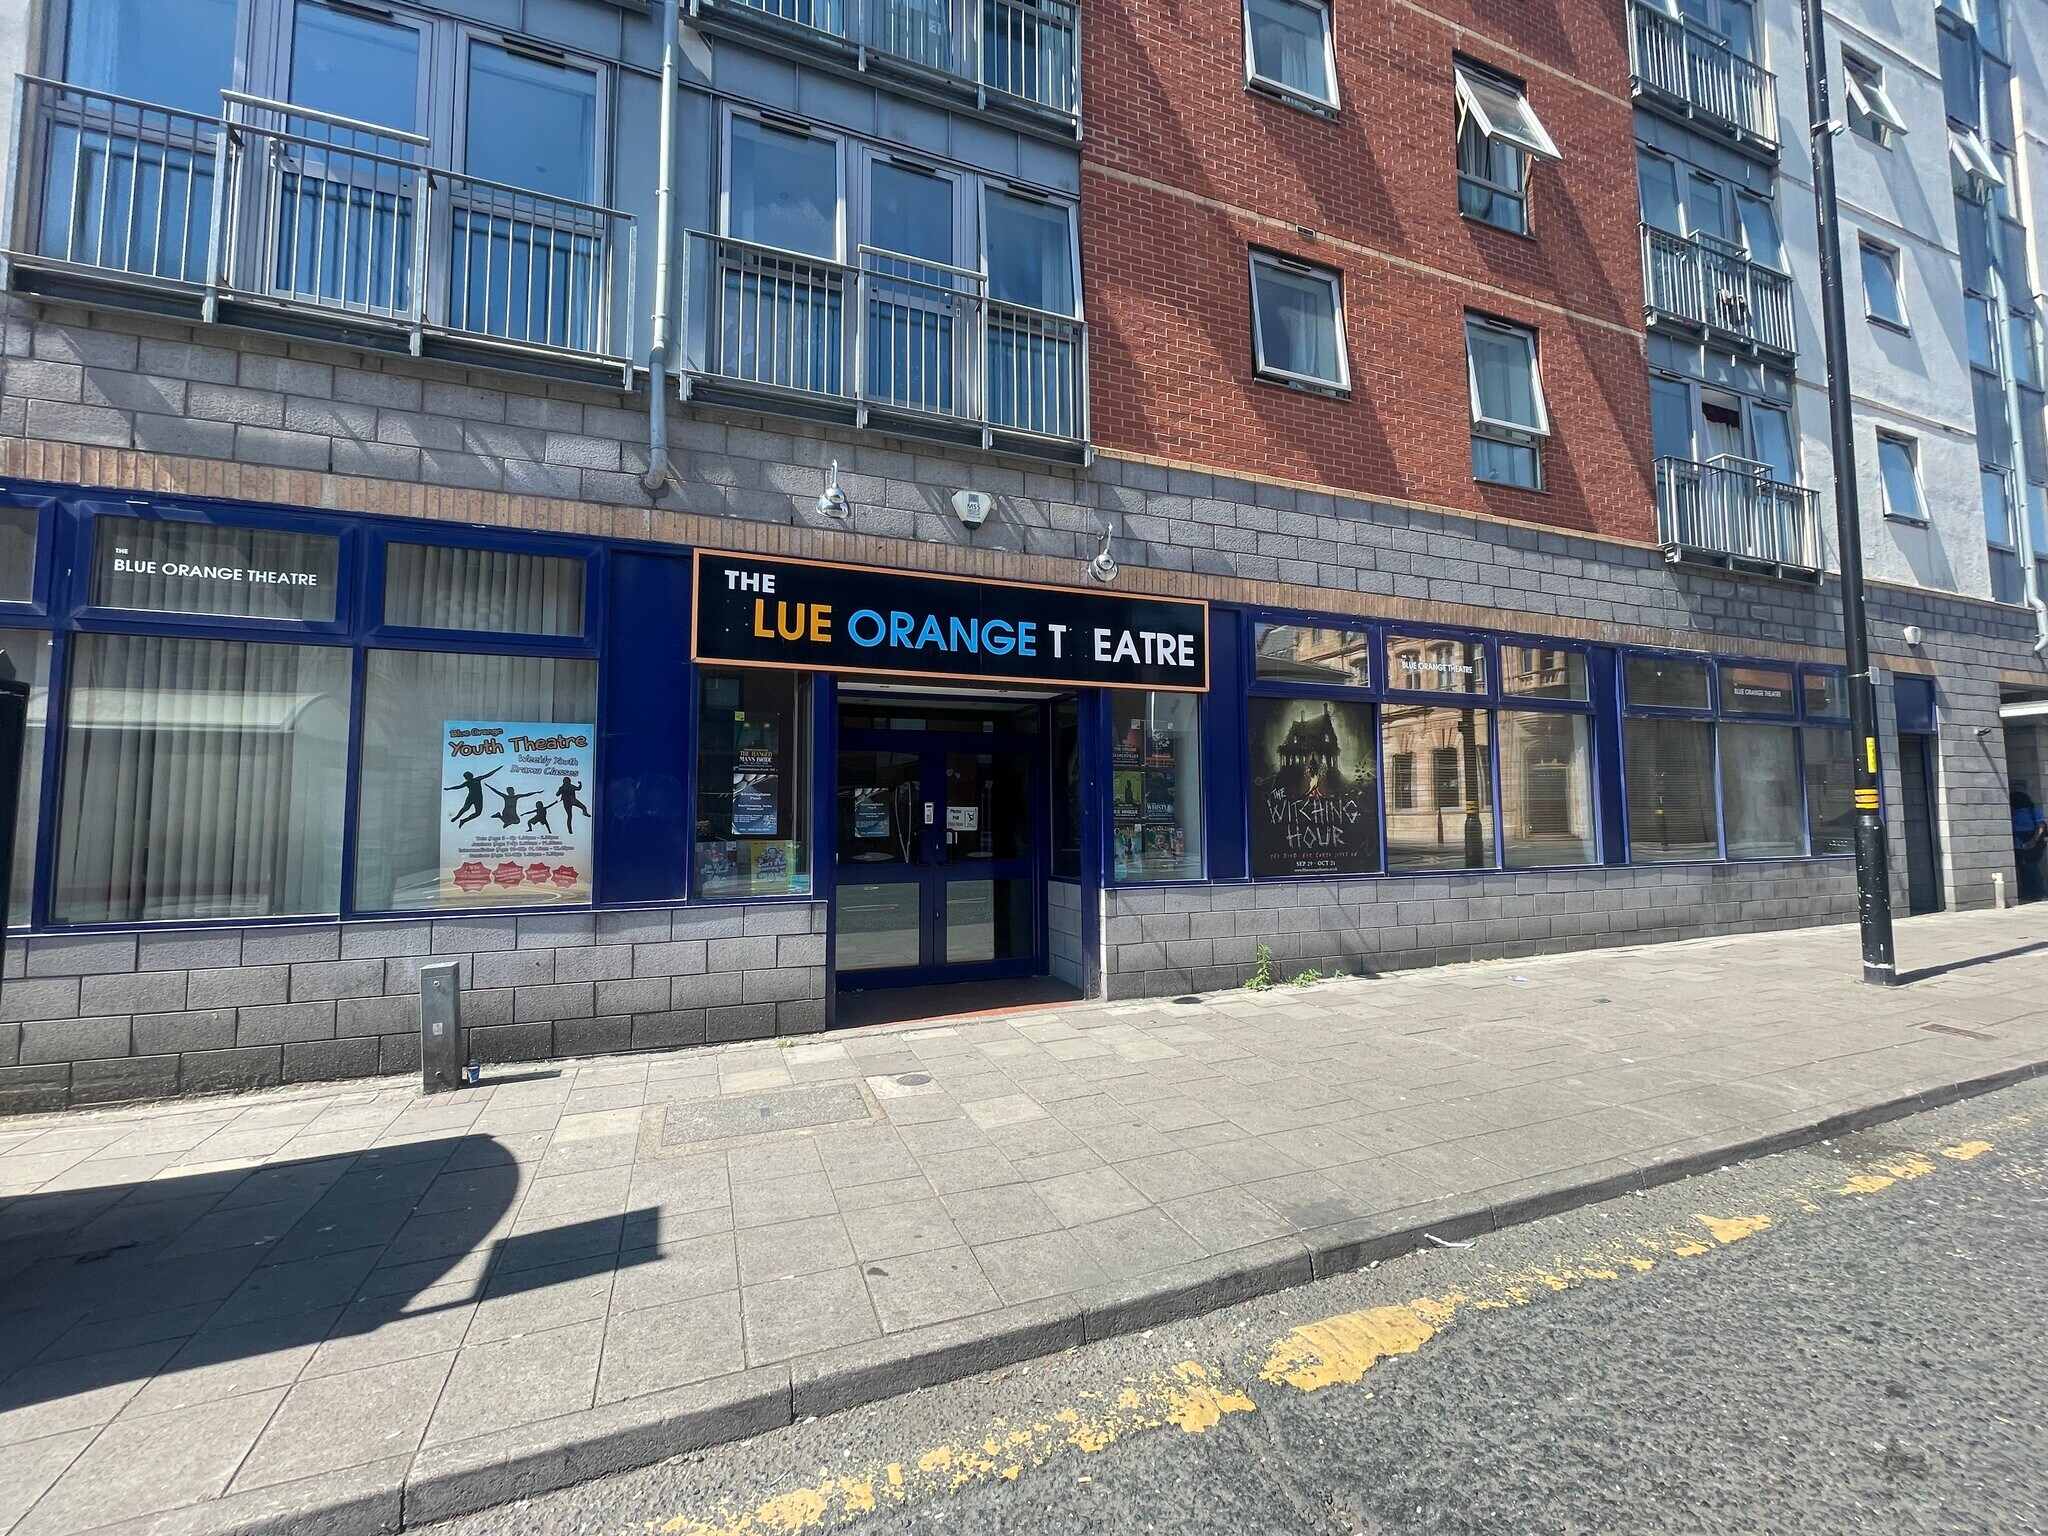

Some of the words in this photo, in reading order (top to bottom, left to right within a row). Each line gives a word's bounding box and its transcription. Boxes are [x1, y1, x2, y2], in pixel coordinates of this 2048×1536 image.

[114, 558, 156, 574] BLUE
[162, 562, 243, 582] ORANGE
[247, 570, 318, 586] THEATRE
[724, 570, 776, 594] THE
[848, 608, 1037, 656] ORANGE
[1402, 661, 1418, 670] BLUE
[1418, 662, 1447, 672] ORANGE
[1448, 664, 1473, 674] THEATRE
[450, 728, 470, 738] Blue
[471, 728, 504, 737] Orange
[448, 738, 504, 758] Youth
[508, 734, 588, 752] Theatre
[510, 764, 542, 775] Drama
[543, 768, 579, 777] Classes
[518, 754, 552, 766] Weekly
[553, 756, 578, 766] Youth
[1270, 787, 1286, 800] THE
[1266, 798, 1361, 825] WITCHING
[1286, 824, 1346, 850] HOUR
